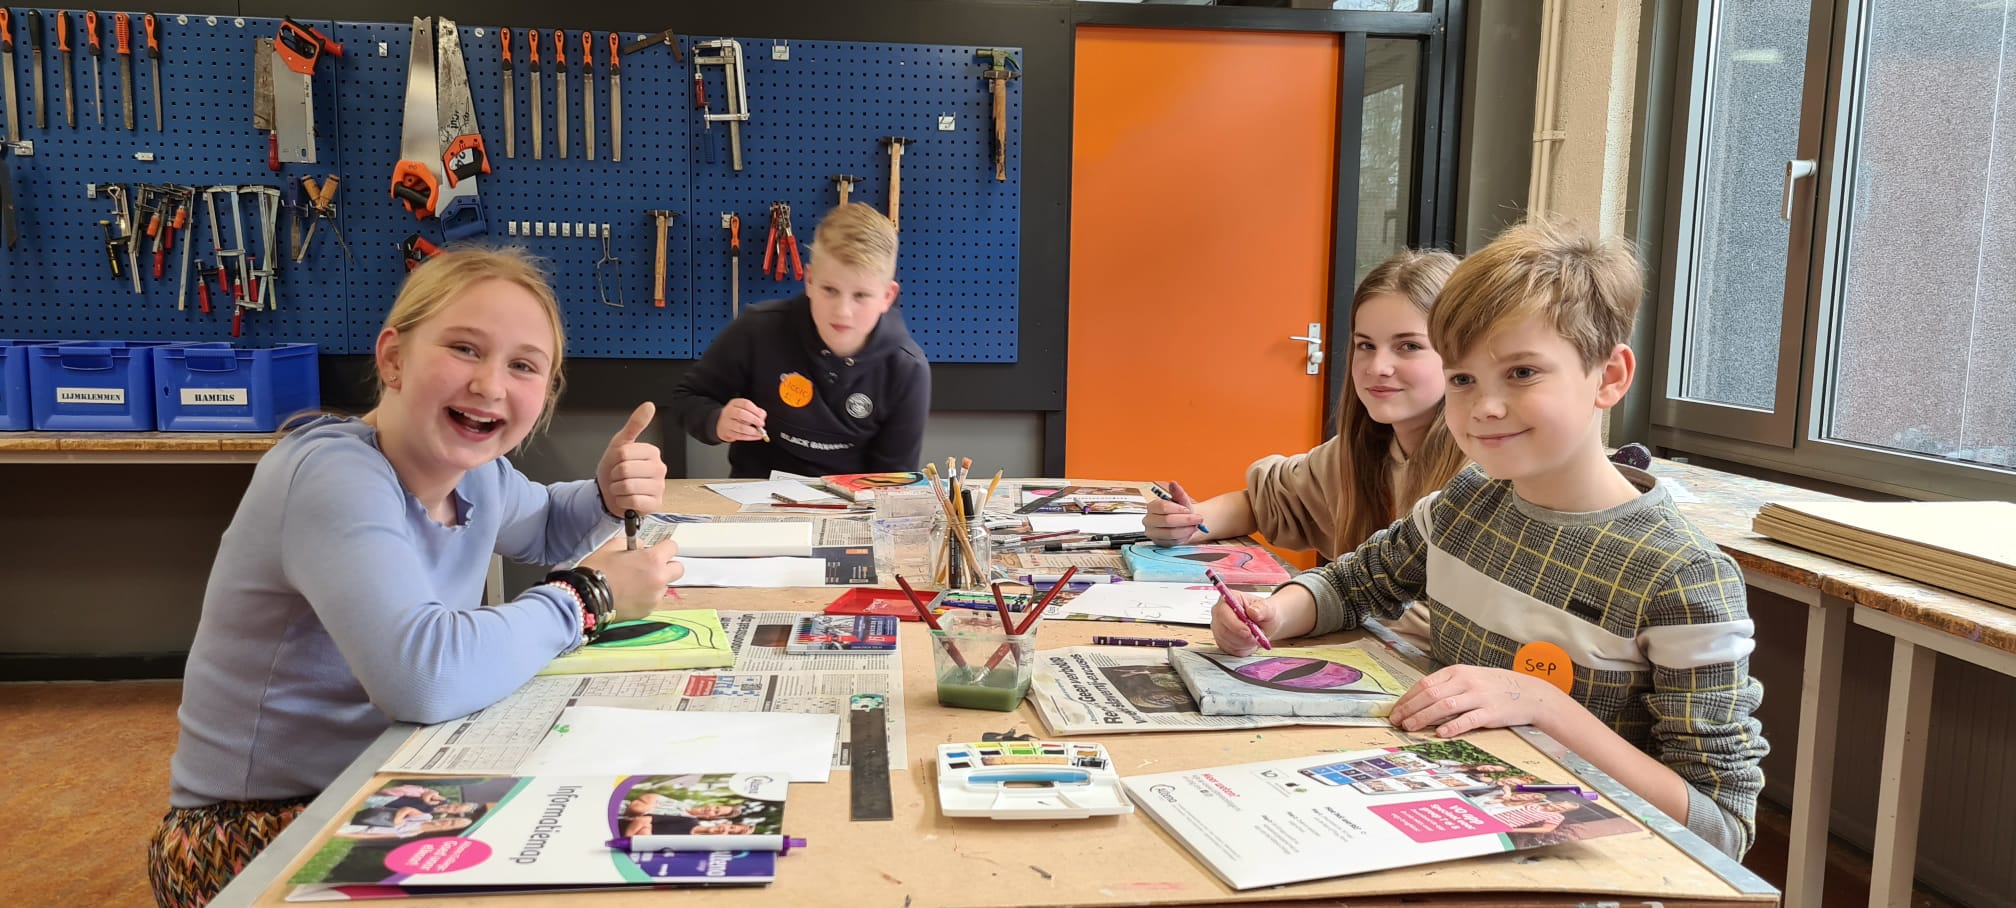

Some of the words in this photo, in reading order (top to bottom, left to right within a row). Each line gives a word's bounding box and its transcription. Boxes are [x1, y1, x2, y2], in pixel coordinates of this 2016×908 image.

[455, 151, 466, 169] 24
[61, 392, 121, 401] LIJMKLEMMEN
[194, 393, 235, 402] HAMERS
[1073, 684, 1096, 702] Geen
[509, 785, 583, 864] Informatiemap
